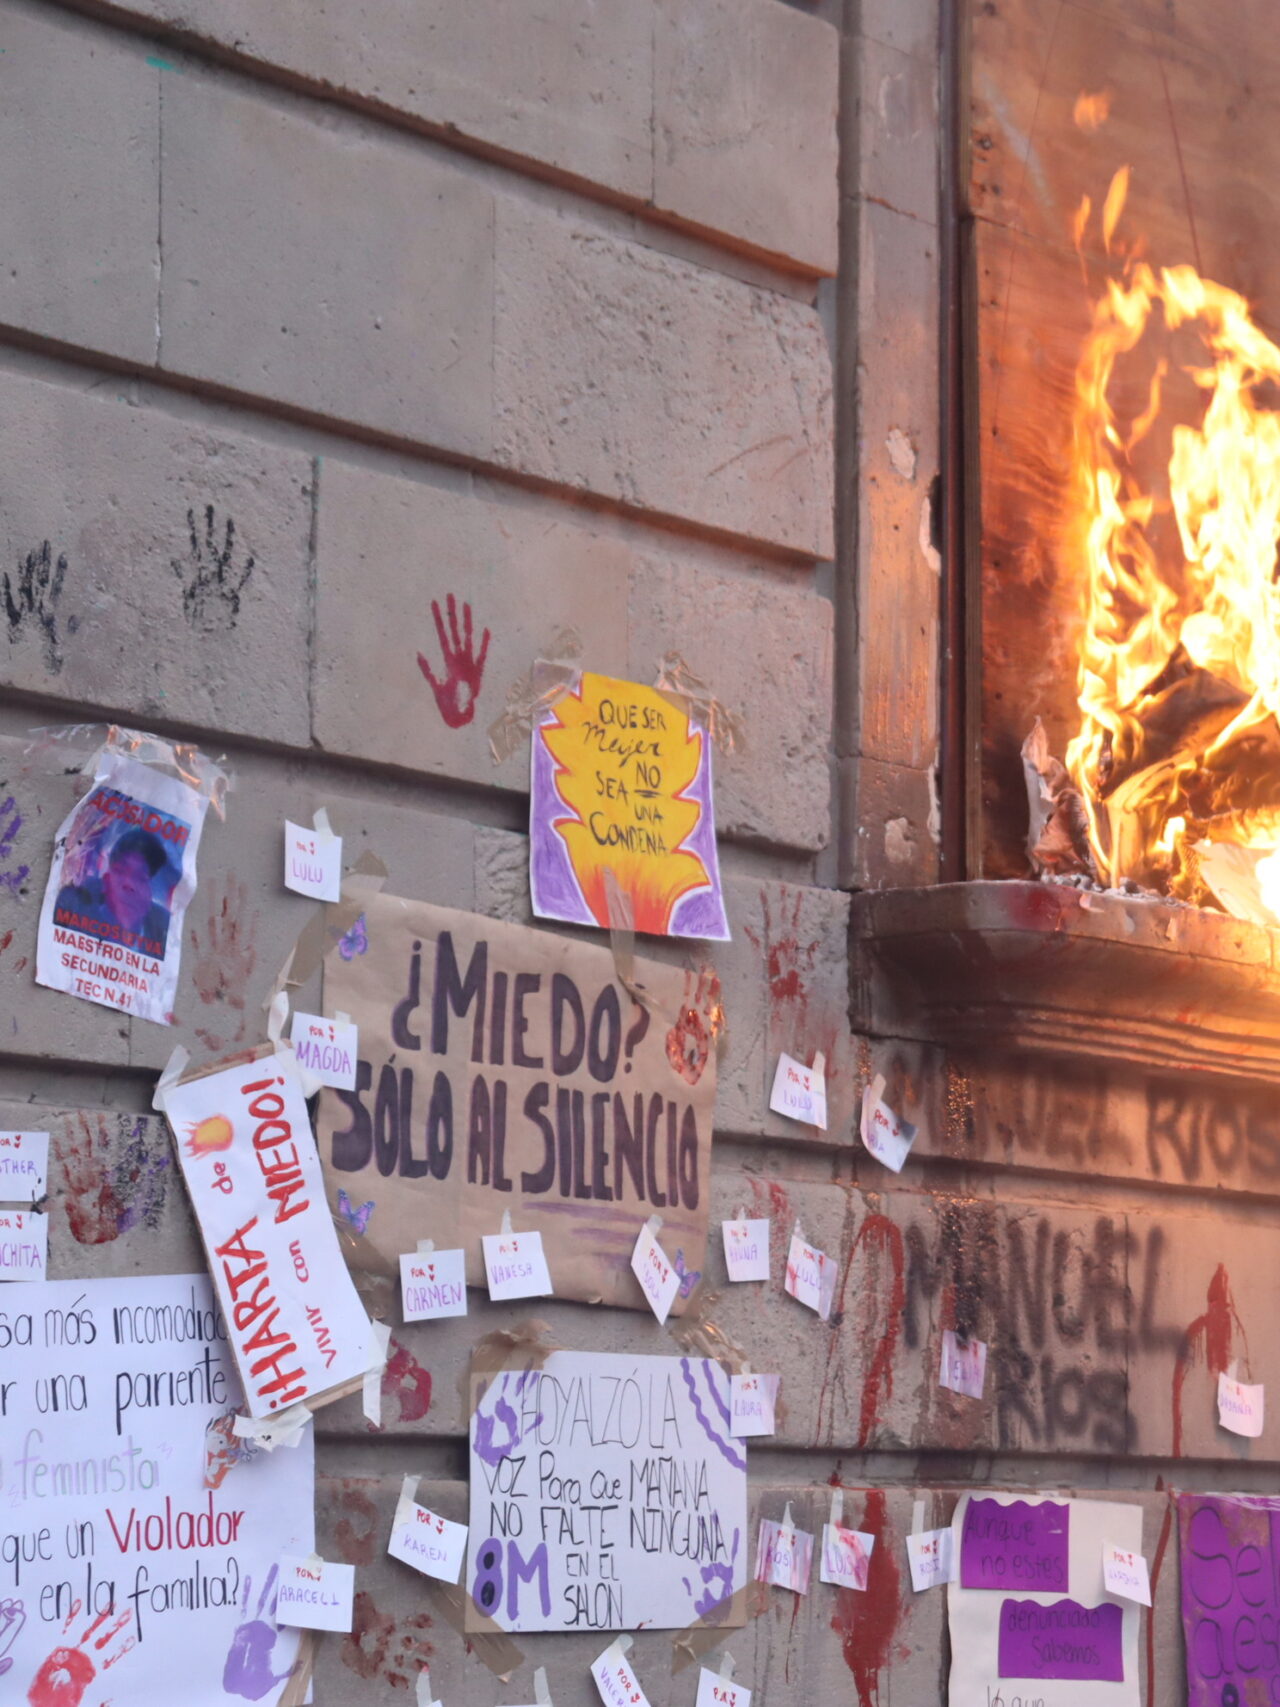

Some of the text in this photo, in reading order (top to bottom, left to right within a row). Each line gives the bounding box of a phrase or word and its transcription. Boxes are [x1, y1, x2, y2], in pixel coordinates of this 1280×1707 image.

[599, 699, 667, 731] QUE SER
[595, 770, 630, 805] SEA
[636, 762, 662, 789] NO
[88, 790, 191, 848] ACOSADOR
[634, 804, 664, 825] UNA
[292, 858, 323, 884] LULU
[56, 908, 120, 939] MARCOS
[54, 928, 161, 977] MAESTRO EN LA
[61, 953, 149, 994] SECUNDARIA
[75, 978, 102, 998] TEC
[391, 930, 651, 1083] ¿MIEDO?
[296, 1041, 352, 1075] MAGDA
[330, 1053, 700, 1211] SÓLO AL SILENCIO
[240, 1075, 310, 1225] MIEDO!
[0, 1158, 38, 1177] THER
[210, 1161, 235, 1195] de
[0, 1243, 42, 1269] CHITA
[289, 1239, 310, 1284] con
[490, 1262, 533, 1286] VANESA
[405, 1282, 462, 1312] CARMEN
[44, 1292, 97, 1347] más
[35, 1372, 88, 1415] una
[116, 1346, 228, 1436] pariente
[520, 1367, 682, 1449] HOY ALZÓ LA
[480, 1455, 528, 1498] VOZ
[629, 1456, 713, 1511] MAÑANA
[416, 1508, 433, 1527] POR
[489, 1501, 729, 1562] NO FALTE NINGUNA
[964, 1510, 1037, 1552] Aunque
[2, 1491, 246, 1587] que un Violador
[403, 1531, 448, 1563] KAREN
[473, 1537, 552, 1621] 8M
[565, 1552, 620, 1582] EN EL
[981, 1555, 1006, 1577] no
[39, 1556, 240, 1643] en la familia?
[279, 1584, 340, 1606] ARACELI
[1030, 1635, 1102, 1669] Sabemos
[600, 1666, 627, 1707] VALER
[617, 1667, 632, 1694] POR
